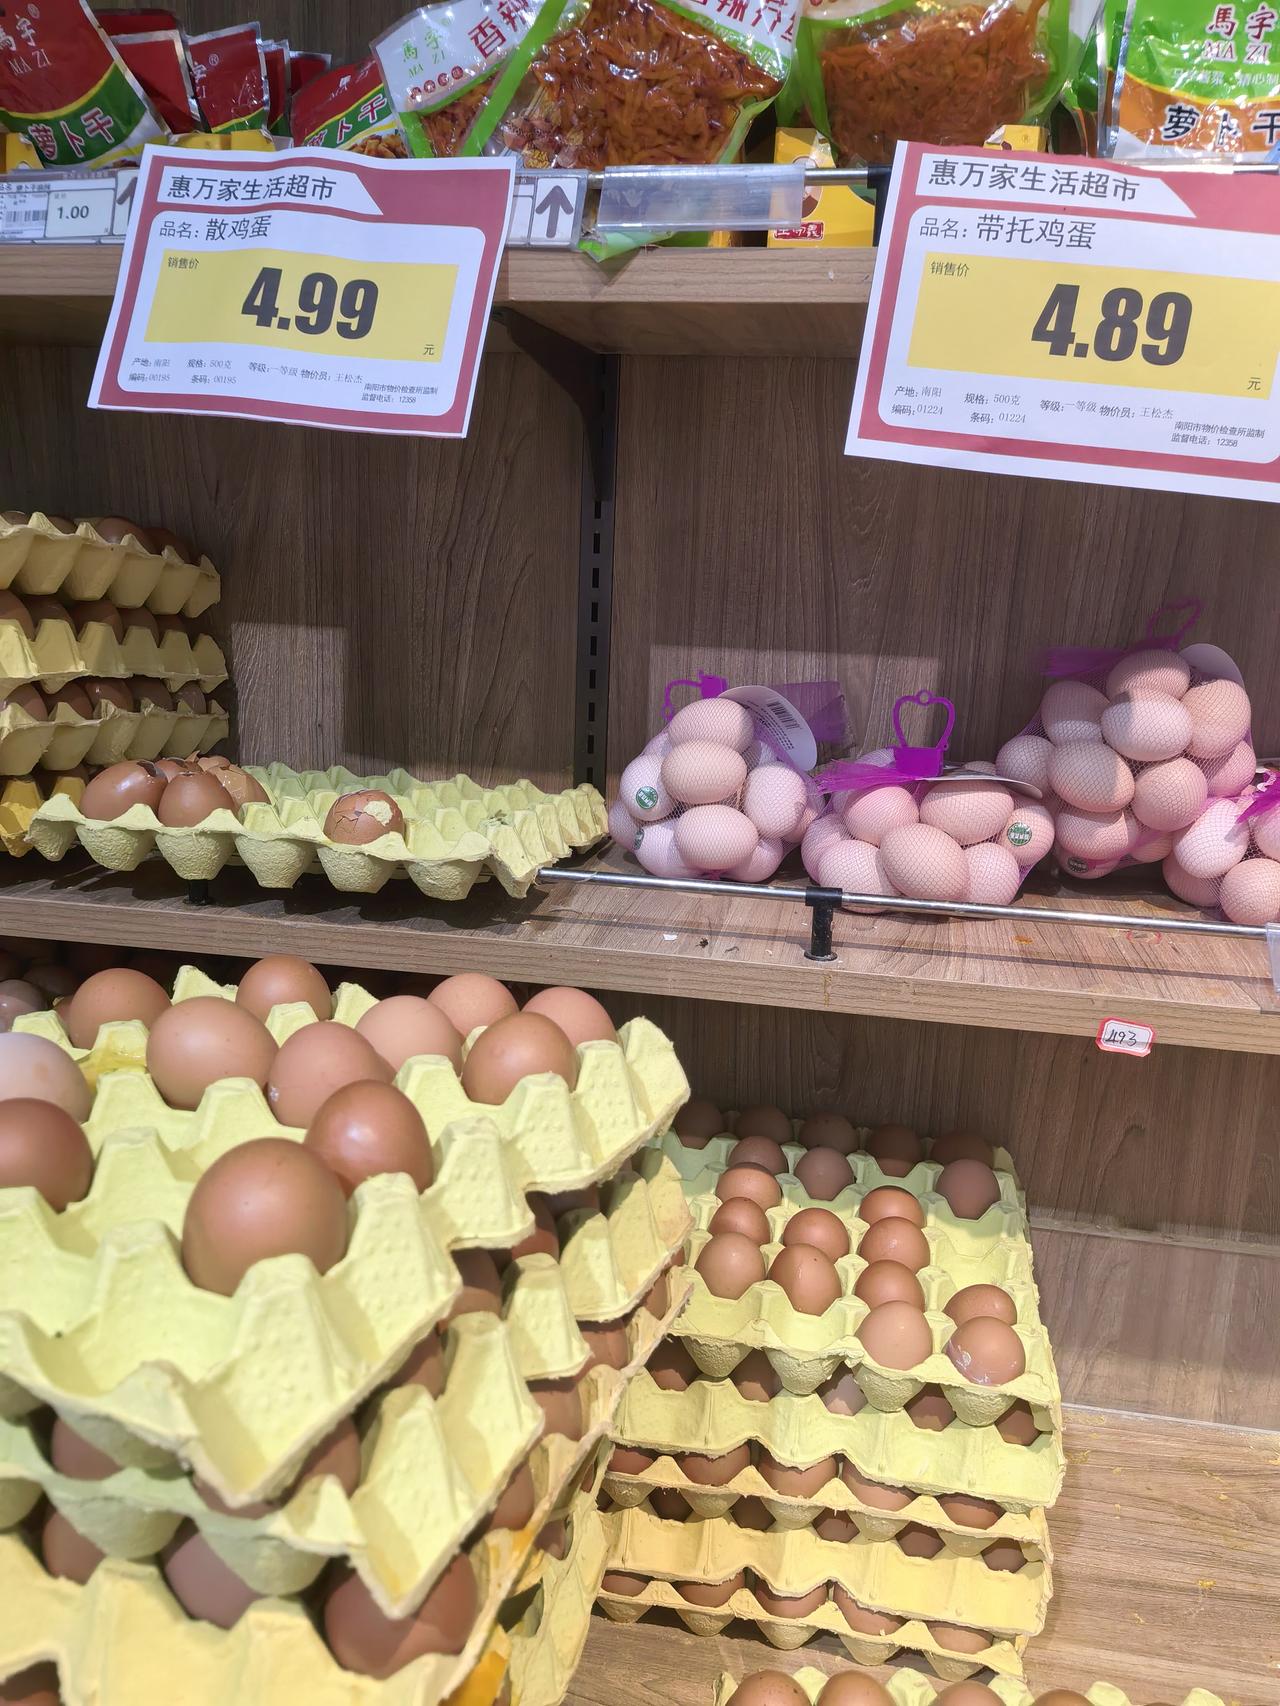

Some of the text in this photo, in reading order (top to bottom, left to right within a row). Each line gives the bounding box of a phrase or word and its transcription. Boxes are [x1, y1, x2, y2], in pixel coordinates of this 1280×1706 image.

[9, 48, 52, 76] MA ZI
[27, 106, 115, 161] 萝卜干
[1160, 104, 1280, 146] 萝卜干
[167, 174, 337, 202] 惠万家生活超市
[928, 158, 1140, 202] 惠万家生活超市
[57, 205, 90, 220] 1.00
[167, 256, 200, 270] 销售价
[929, 260, 970, 277] 销售价
[240, 266, 380, 341] 4.99
[1031, 283, 1194, 367] 4.89
[422, 343, 435, 356] 元
[1248, 376, 1262, 391] 元
[1173, 420, 1265, 439] 南阳市物价检查所监制
